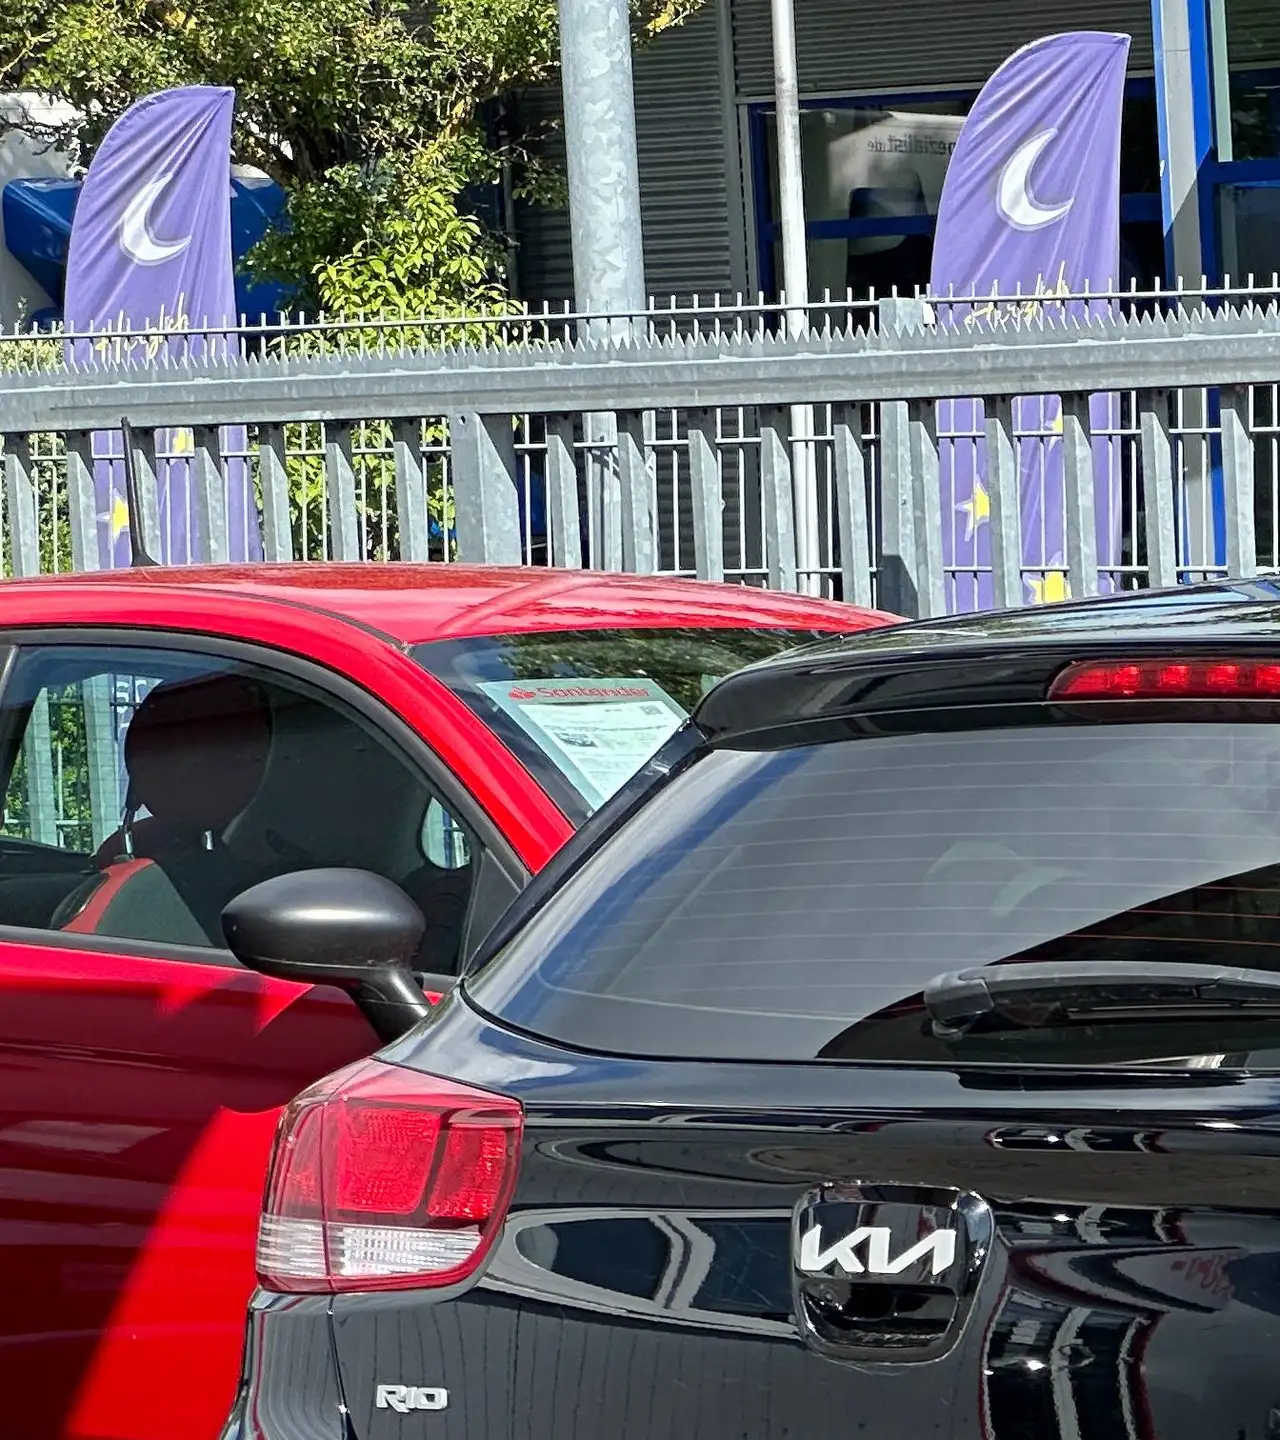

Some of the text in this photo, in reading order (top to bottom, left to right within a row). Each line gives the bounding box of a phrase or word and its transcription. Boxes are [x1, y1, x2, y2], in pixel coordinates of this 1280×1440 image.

[536, 686, 650, 698] Santander
[801, 1224, 956, 1275] KIA
[376, 1385, 448, 1413] RIO
